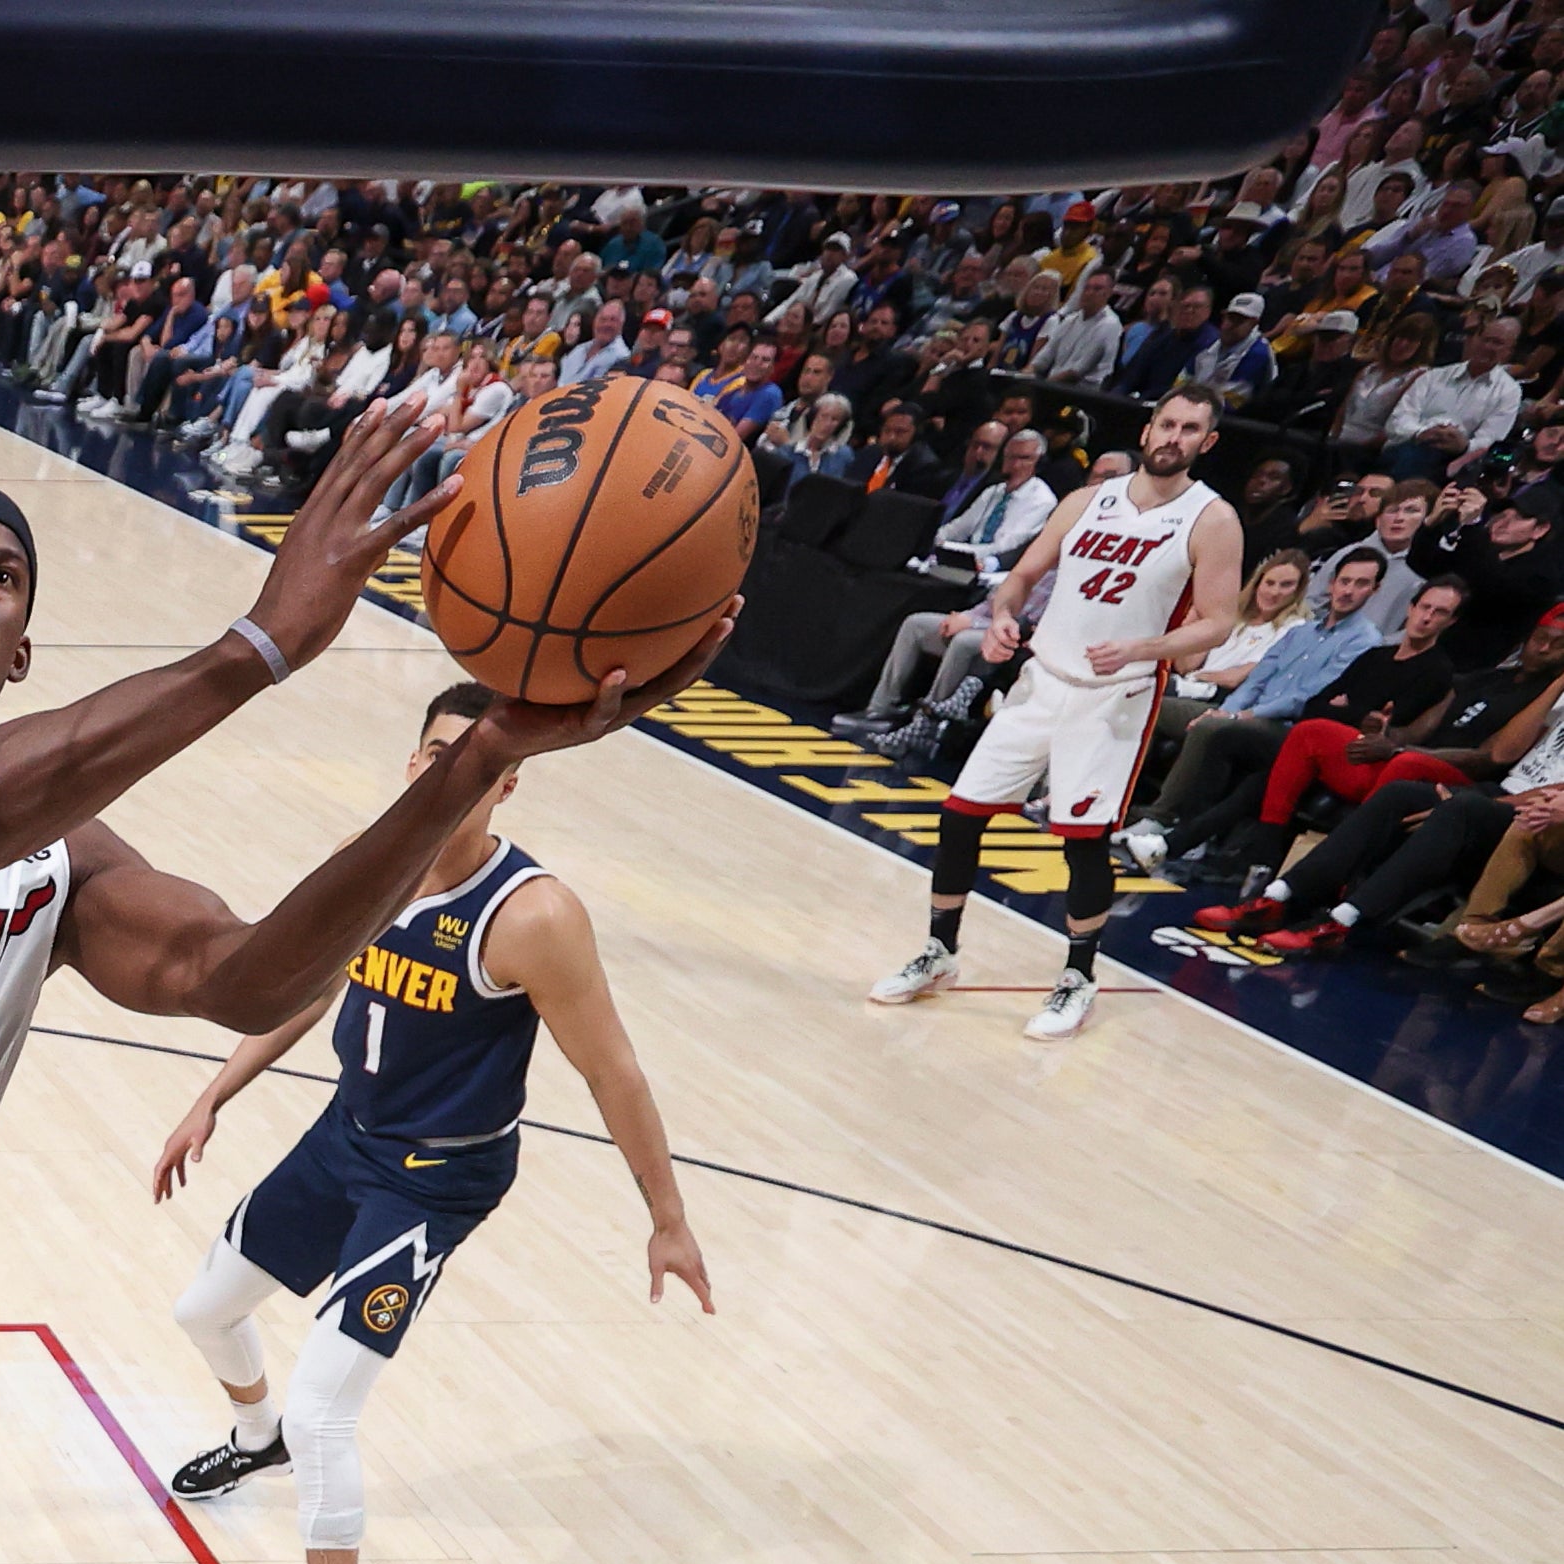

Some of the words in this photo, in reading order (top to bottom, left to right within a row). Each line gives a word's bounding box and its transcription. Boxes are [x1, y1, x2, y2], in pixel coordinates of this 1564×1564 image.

[1069, 528, 1175, 567] HEAT
[1079, 567, 1137, 604] 42
[437, 913, 470, 937] WU
[346, 944, 460, 1013] ENVER
[363, 1001, 387, 1075] 1
